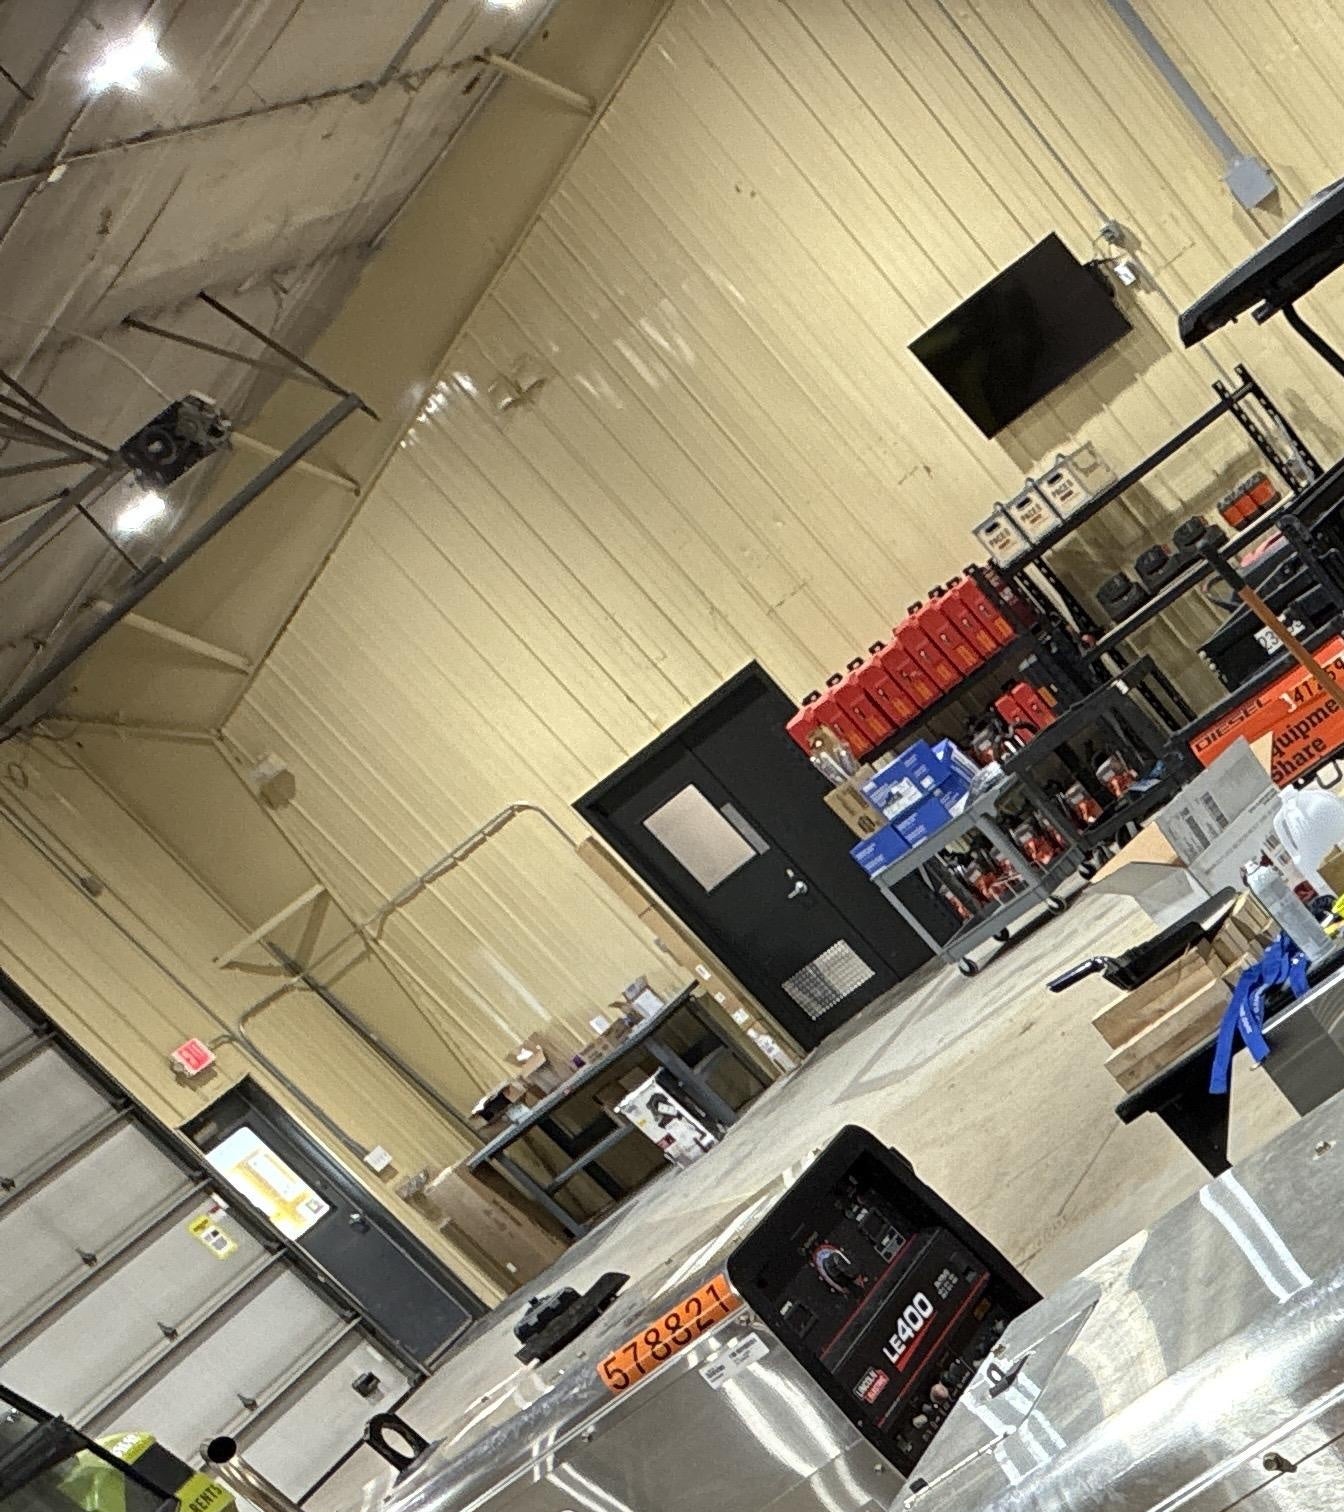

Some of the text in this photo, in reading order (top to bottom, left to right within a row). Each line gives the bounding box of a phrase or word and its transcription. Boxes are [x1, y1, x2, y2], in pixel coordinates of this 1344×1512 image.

[1194, 695, 1275, 754] DIESEL
[602, 1283, 734, 1392] 578821
[882, 1291, 935, 1365] LE400
